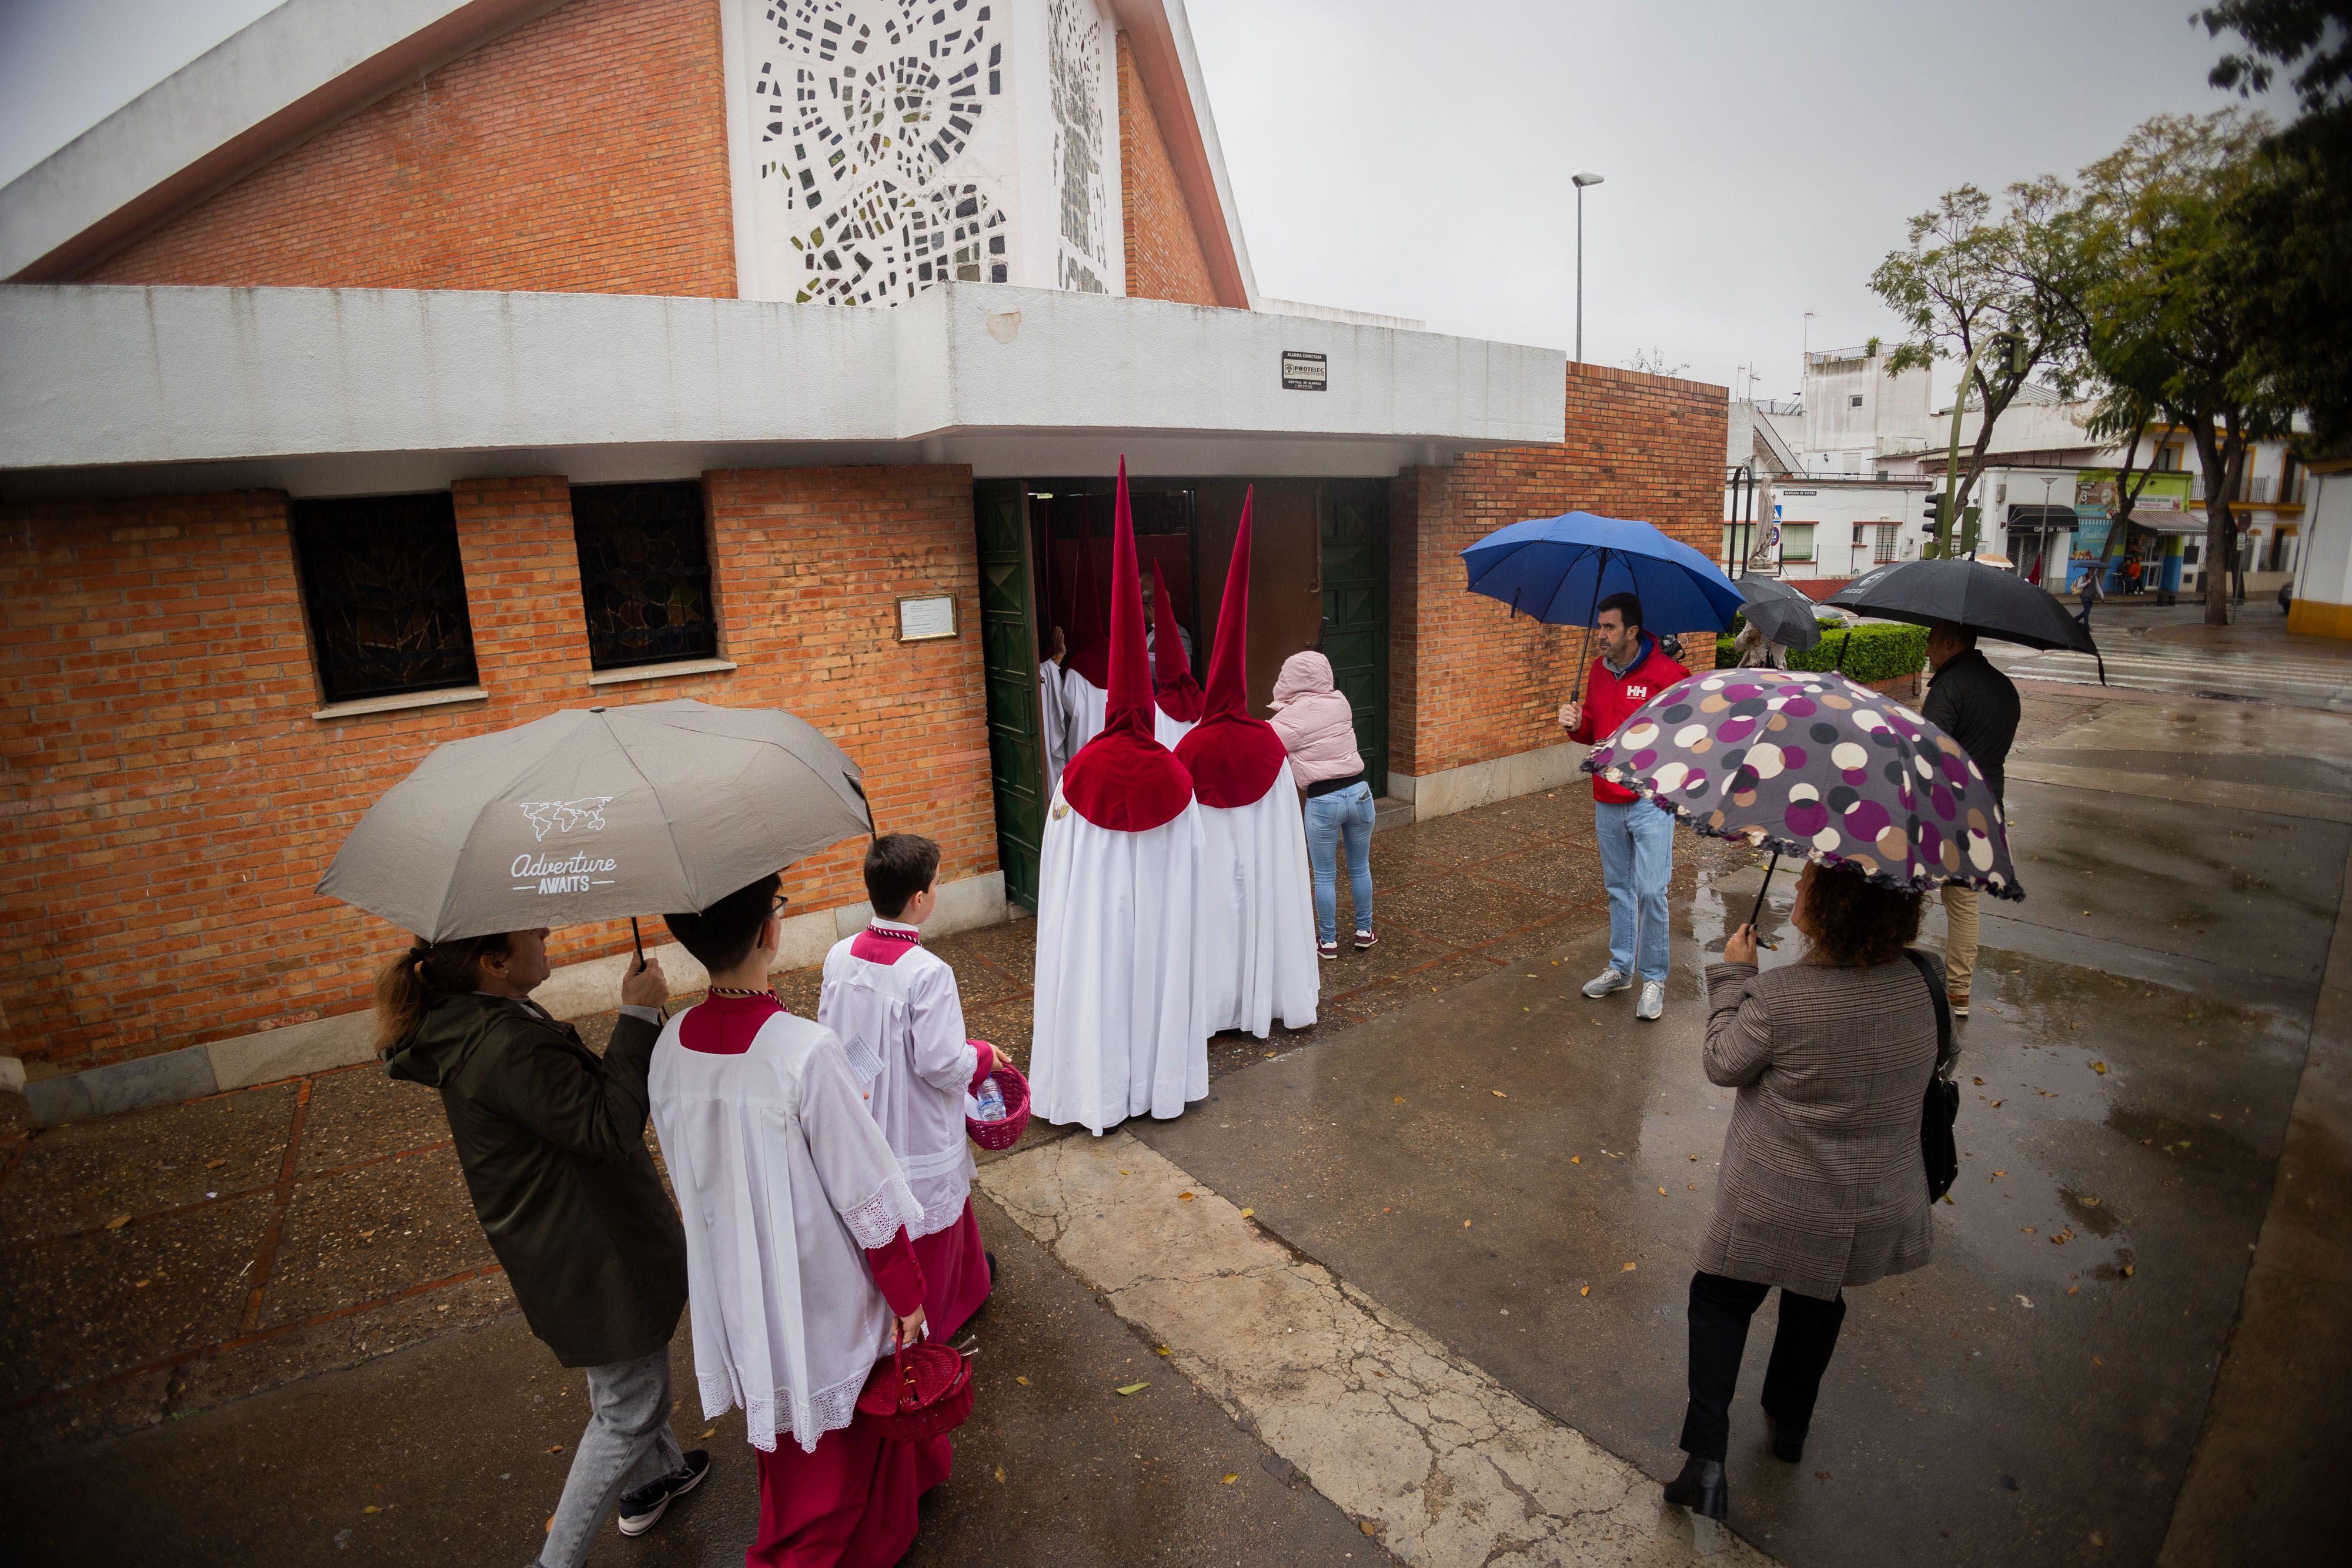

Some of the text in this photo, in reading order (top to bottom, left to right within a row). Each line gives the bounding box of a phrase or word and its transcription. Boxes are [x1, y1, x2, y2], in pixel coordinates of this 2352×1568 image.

[2082, 490, 2087, 502] 3
[1626, 685, 1647, 698] HH
[511, 850, 617, 878] Adventure
[538, 875, 589, 895] AWAITS
